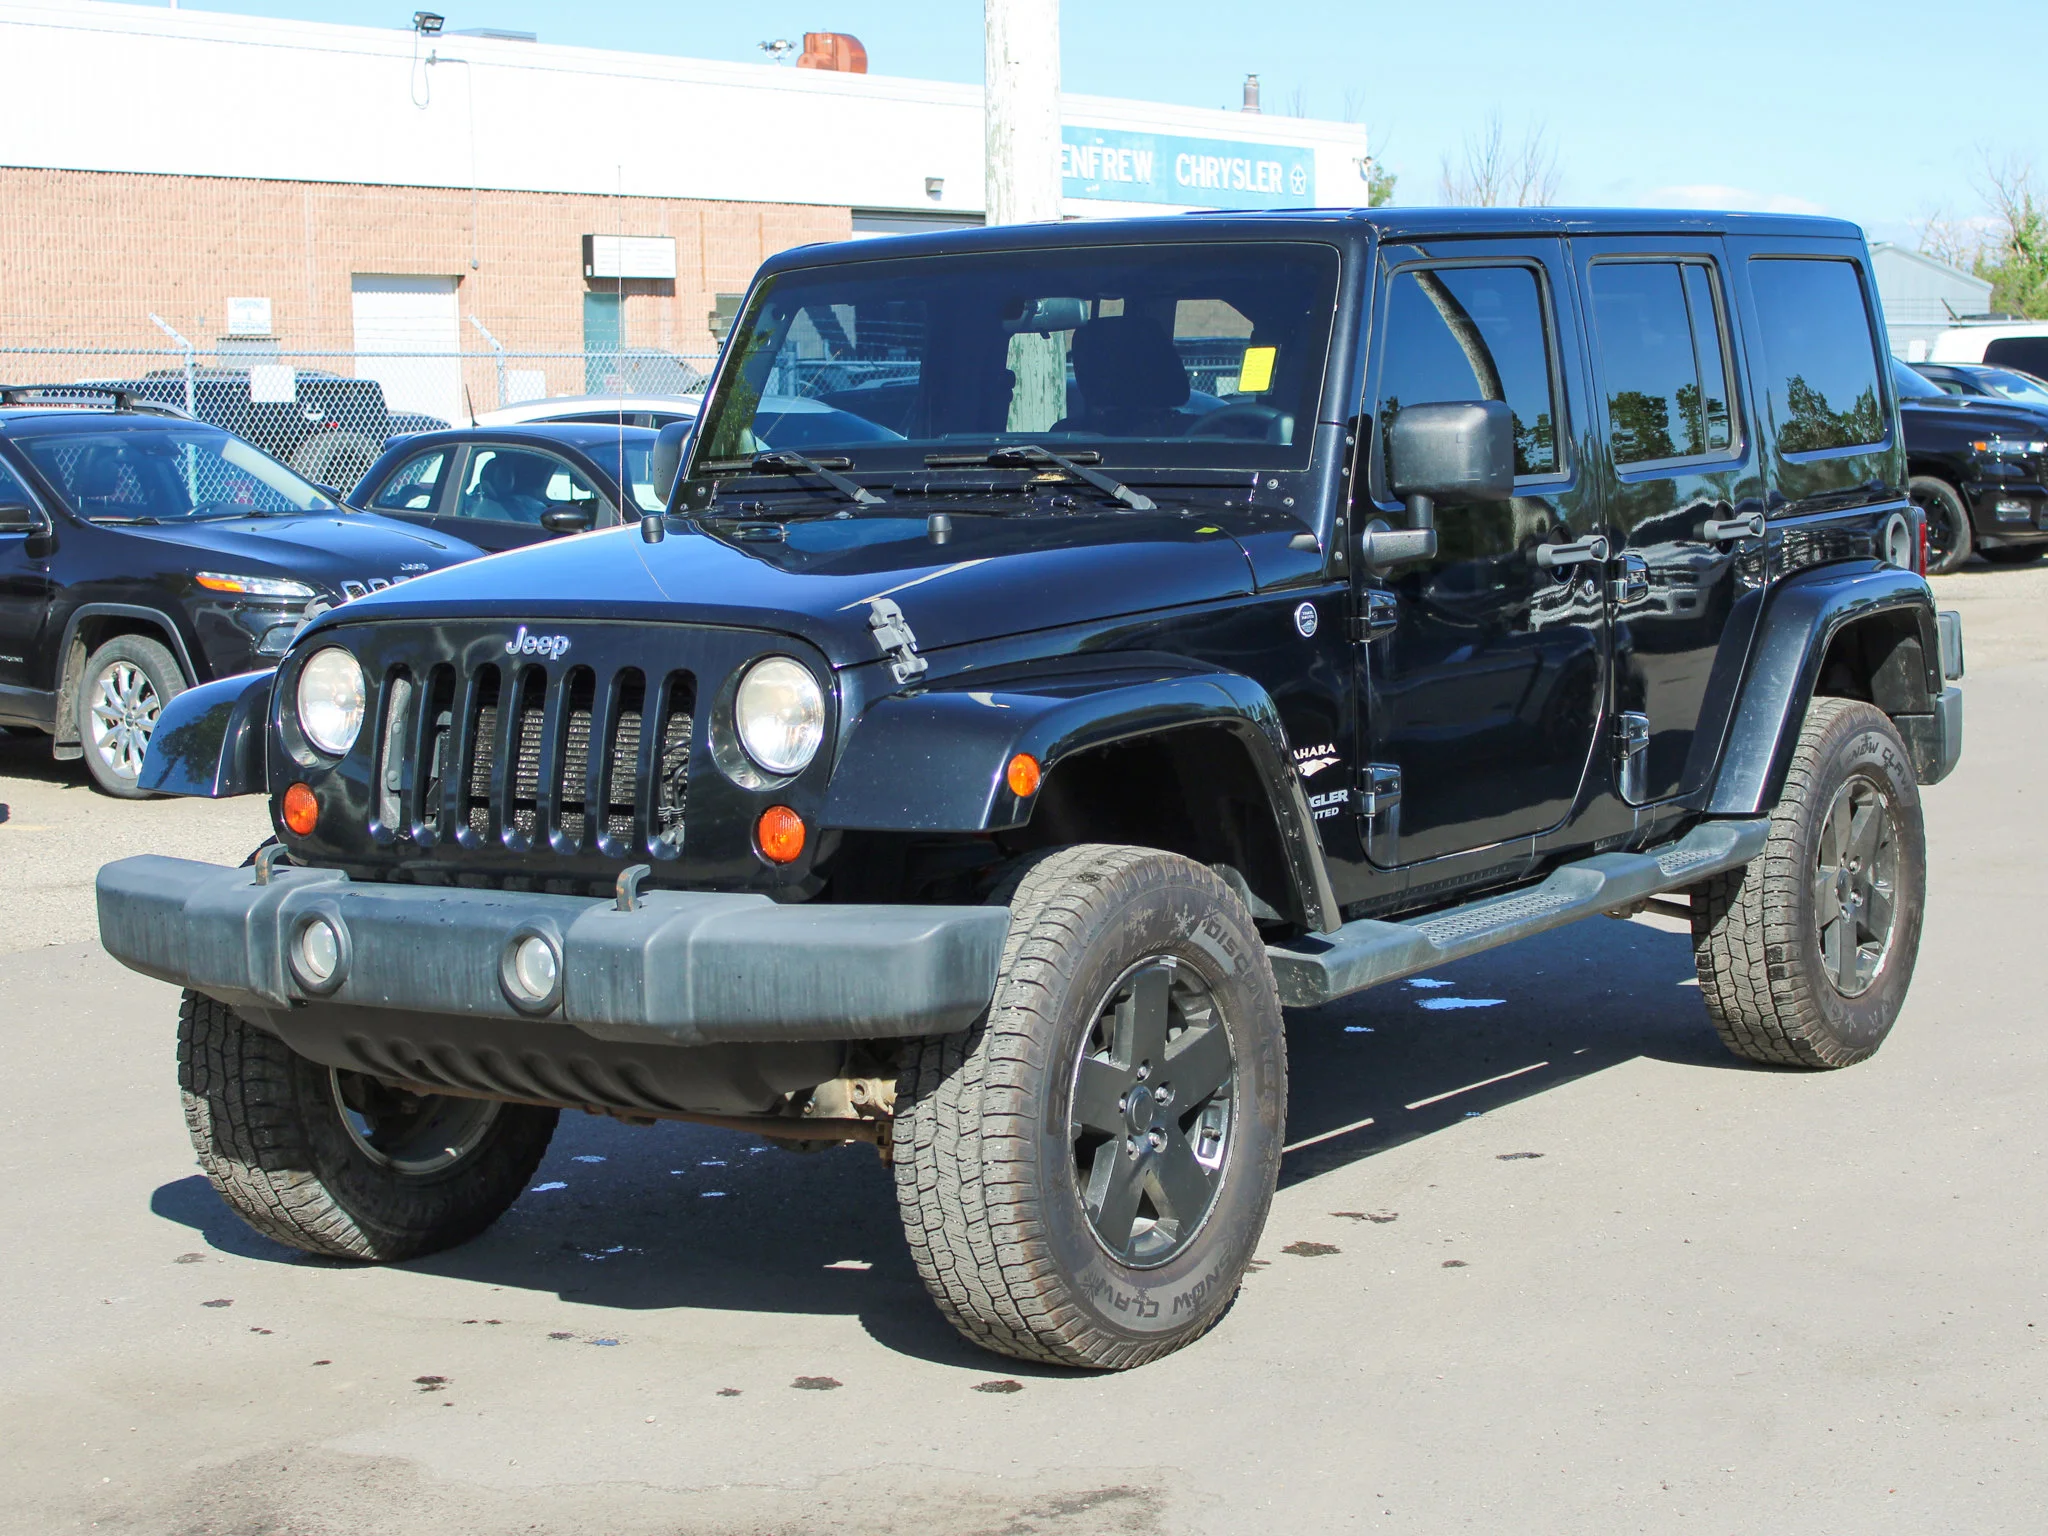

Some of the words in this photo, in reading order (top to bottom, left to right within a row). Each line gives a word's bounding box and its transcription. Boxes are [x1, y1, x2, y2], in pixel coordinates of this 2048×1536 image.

[1175, 152, 1284, 194] CHRYSLER
[505, 625, 571, 660] Jeep
[1308, 789, 1349, 808] GLER
